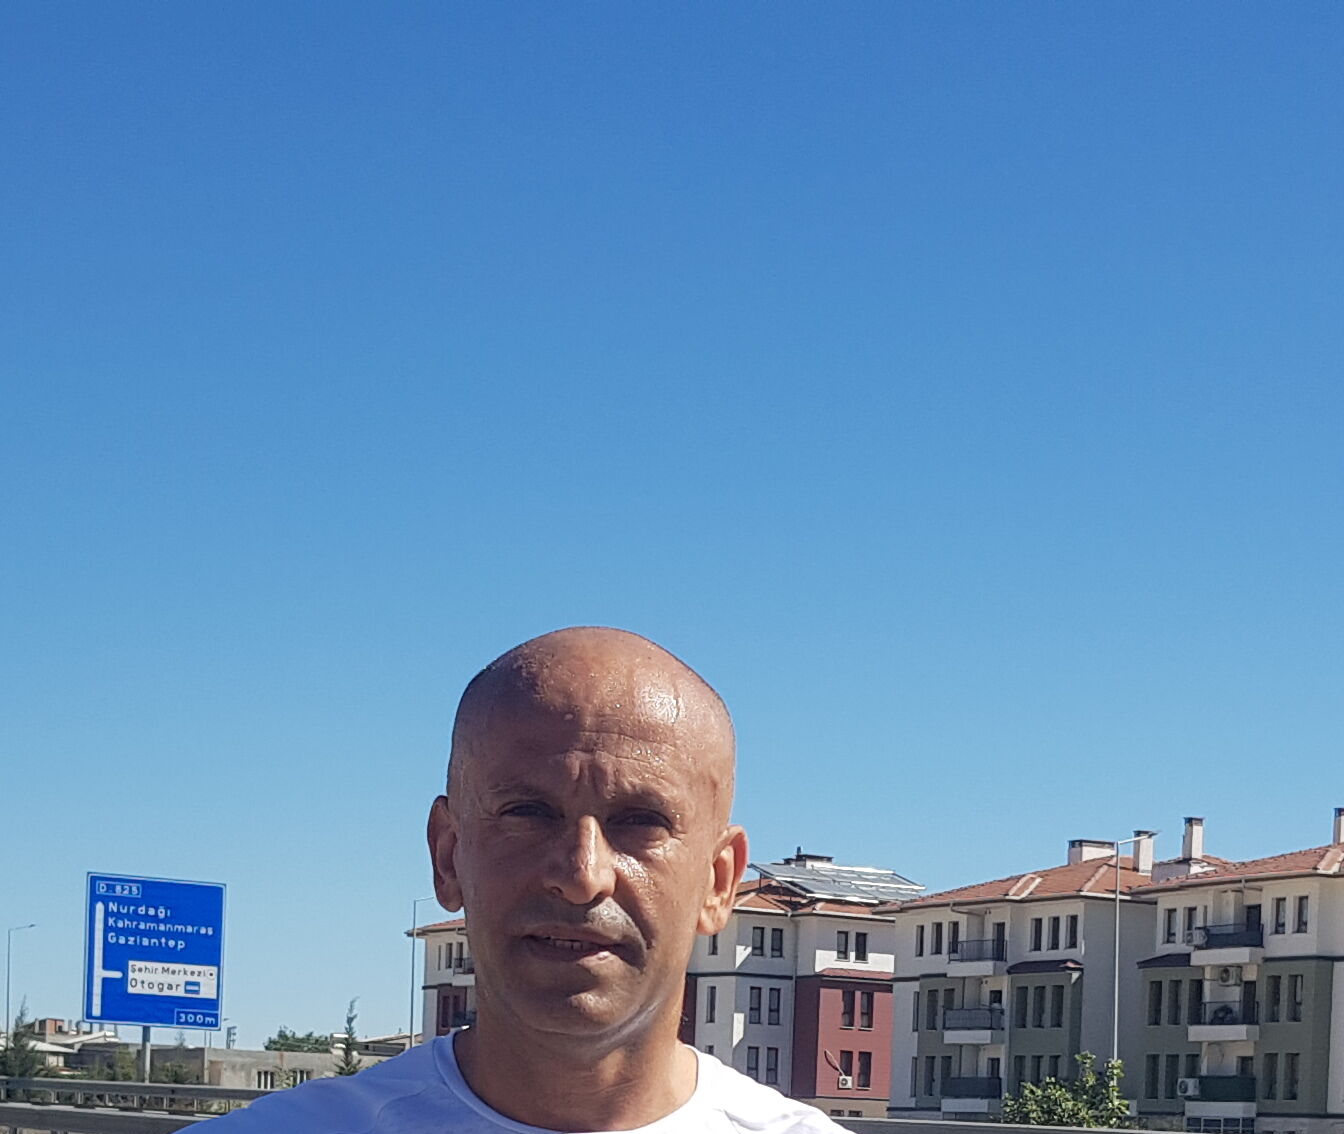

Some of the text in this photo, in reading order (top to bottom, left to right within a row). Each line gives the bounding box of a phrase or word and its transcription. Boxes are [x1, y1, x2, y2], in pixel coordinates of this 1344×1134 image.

[108, 901, 171, 919] Nurdağı
[108, 917, 213, 936] Kahramanmaraş
[108, 932, 186, 951] Gaziantep
[161, 966, 206, 977] Merkezi
[129, 977, 181, 992] Otogar
